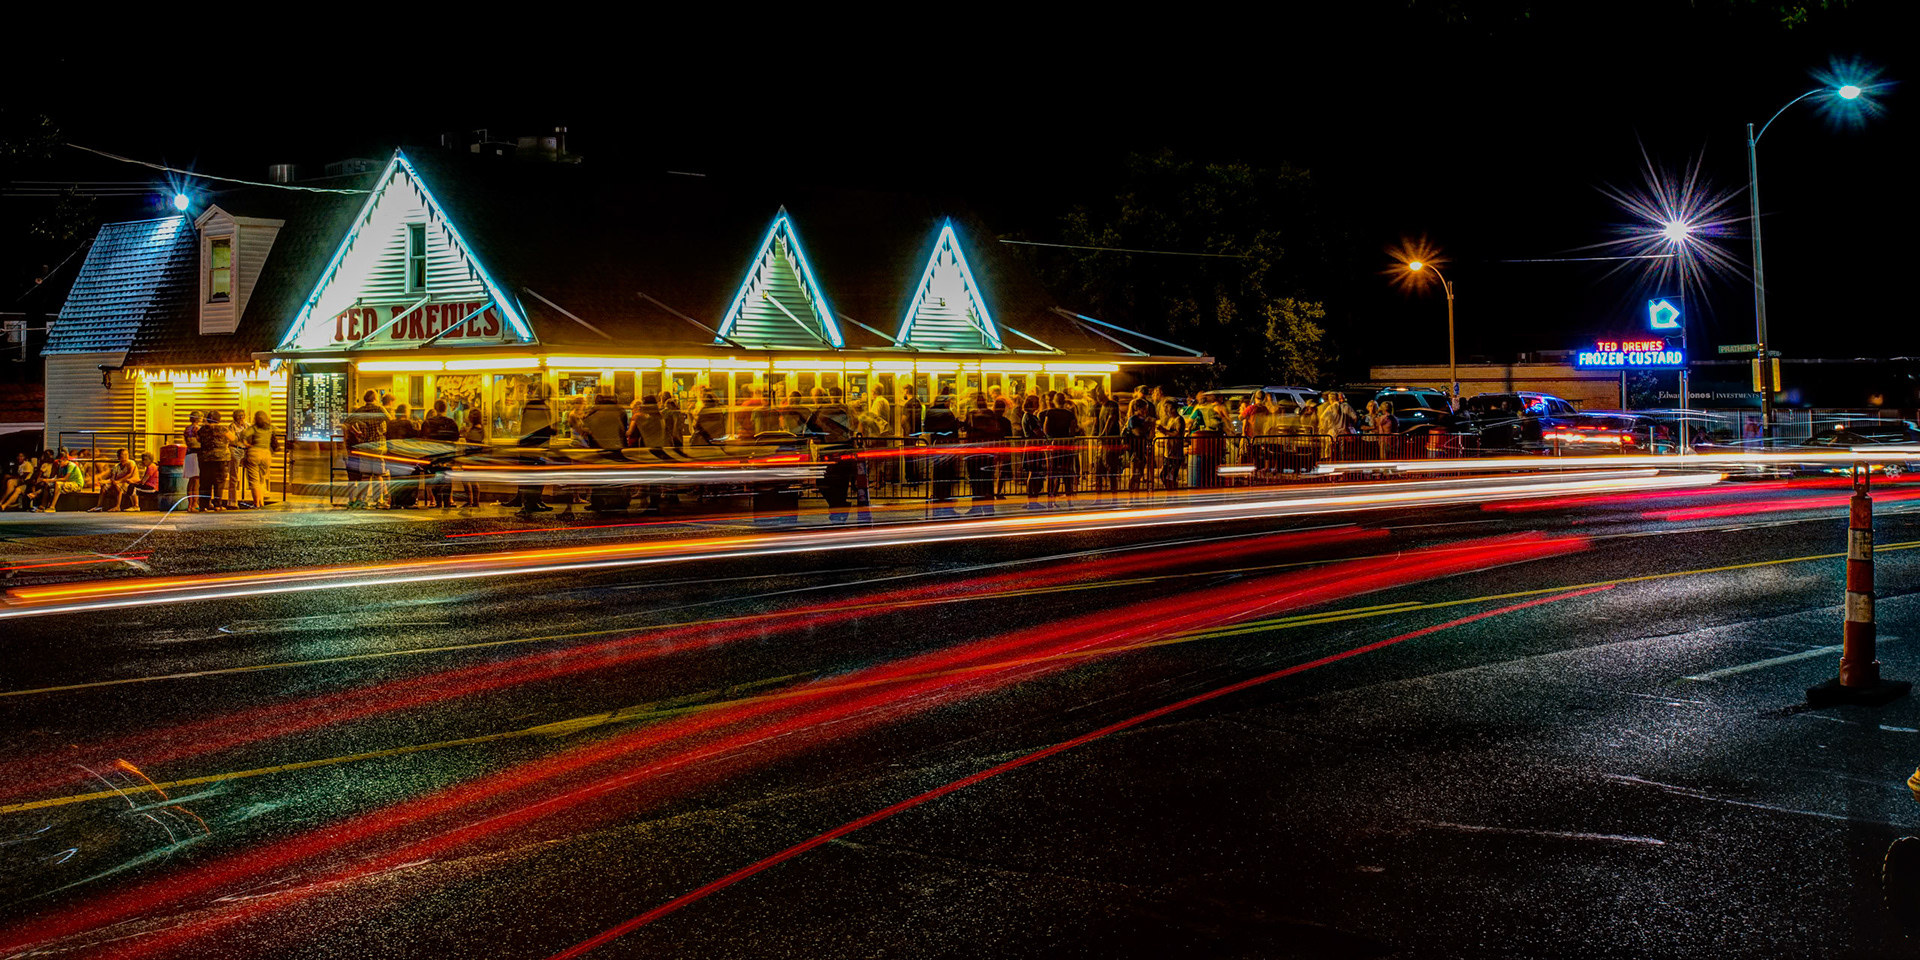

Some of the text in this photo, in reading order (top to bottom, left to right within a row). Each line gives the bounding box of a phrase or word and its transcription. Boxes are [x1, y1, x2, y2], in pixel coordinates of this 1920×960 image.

[334, 302, 500, 341] TED DREWES
[1597, 341, 1663, 353] TED DREWES
[1720, 345, 1752, 353] PRATHER
[1658, 391, 1682, 399] Edwar
